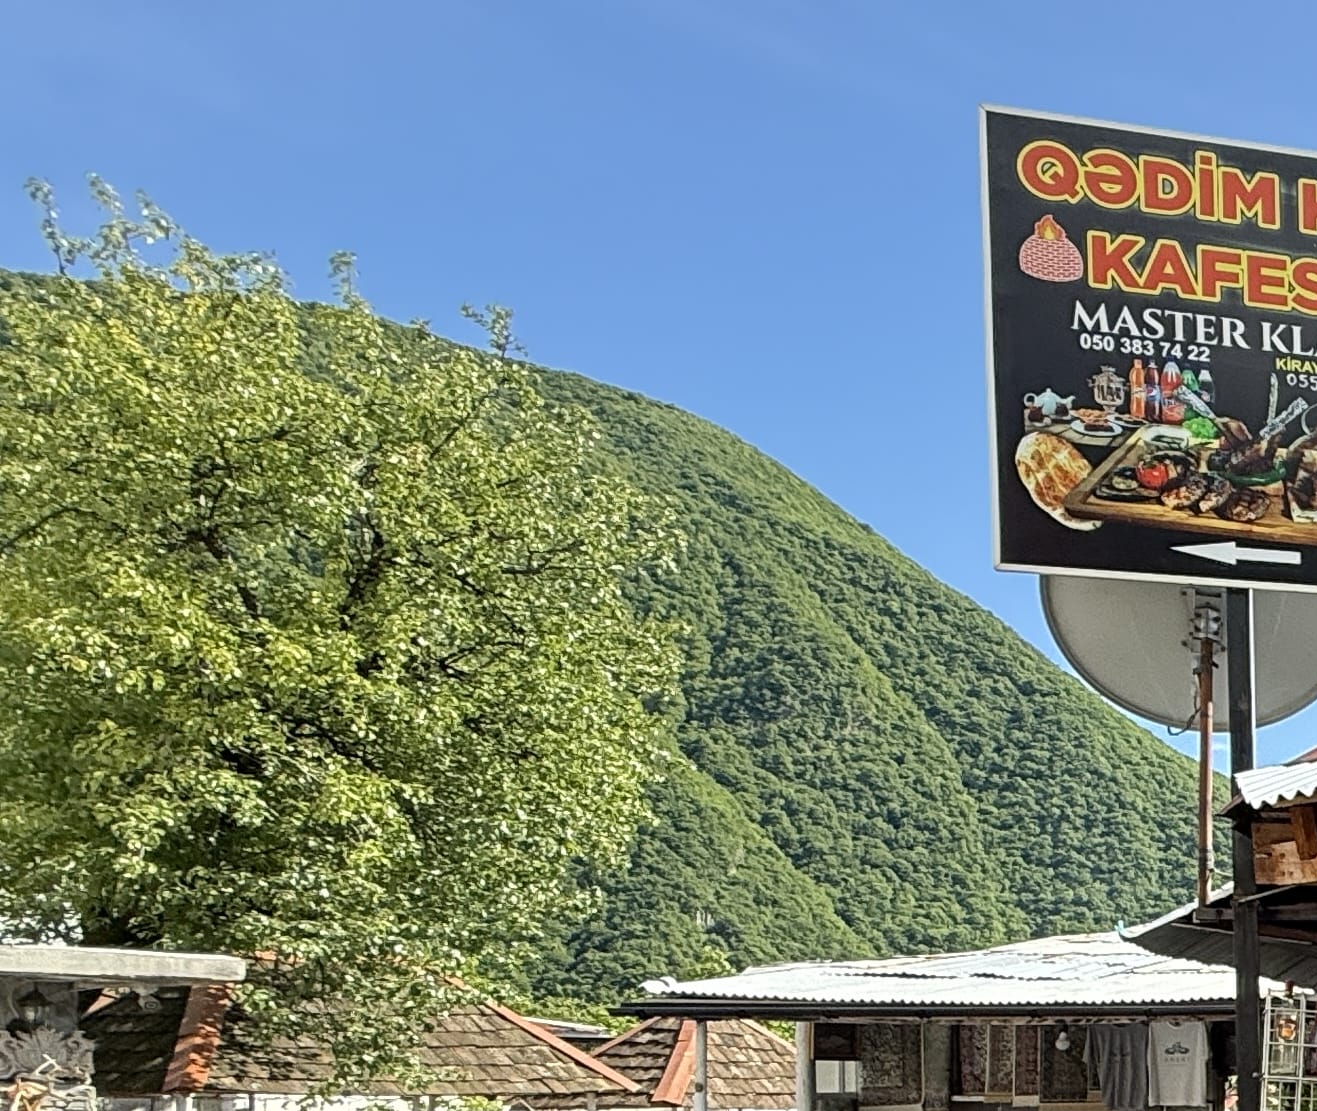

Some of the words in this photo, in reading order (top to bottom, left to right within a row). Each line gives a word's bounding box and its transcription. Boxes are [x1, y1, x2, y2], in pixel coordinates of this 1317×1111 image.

[1016, 139, 1280, 229] QƏDİM
[1071, 300, 1251, 351] MASTER
[1080, 333, 1115, 351] 050
[1120, 337, 1154, 357] 383
[1159, 342, 1183, 360] 74
[1187, 345, 1211, 363] 22
